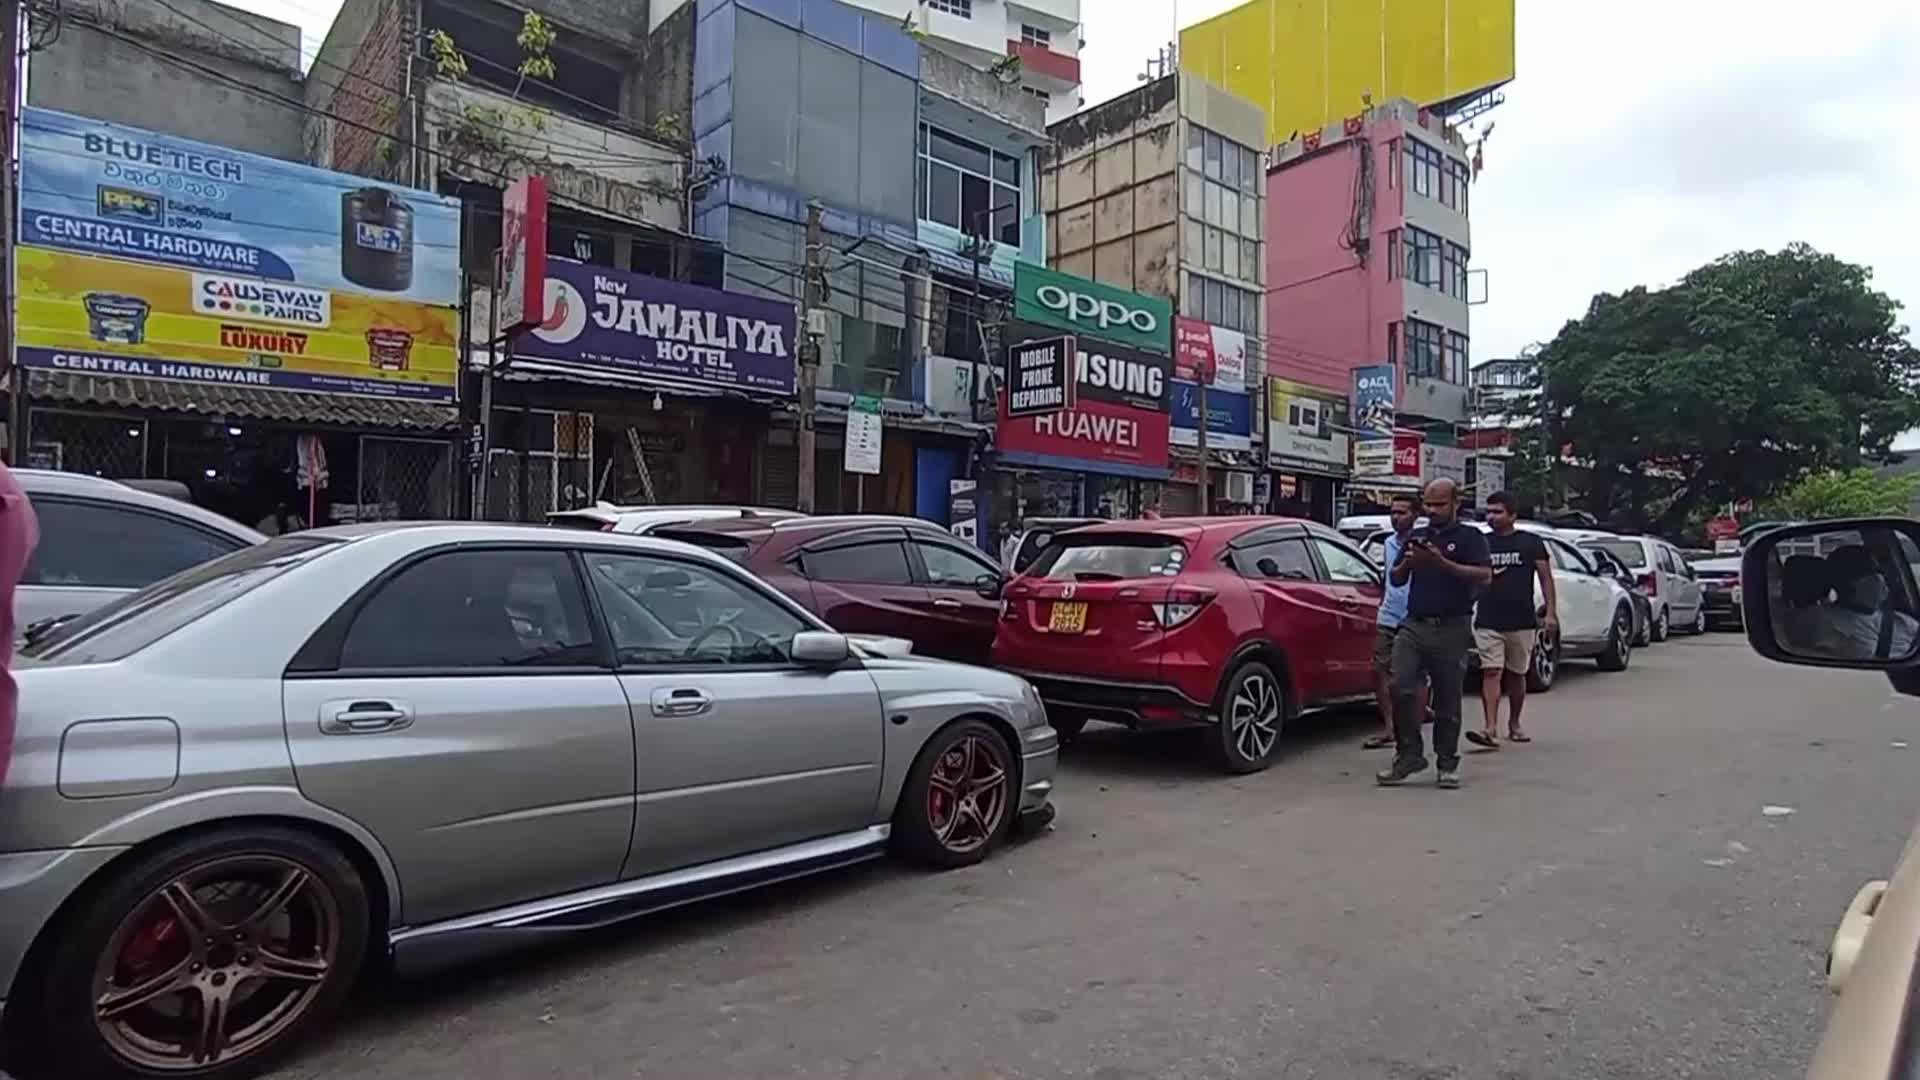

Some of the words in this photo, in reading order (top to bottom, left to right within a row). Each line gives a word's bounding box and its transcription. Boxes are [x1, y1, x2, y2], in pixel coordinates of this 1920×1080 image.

[35, 214, 141, 247] CENTRAL
[144, 233, 260, 265] HARDWARE
[203, 279, 323, 309] CAUSEWAY
[593, 275, 628, 295] New
[591, 292, 788, 357] JAMALIYA
[221, 331, 308, 355] LUXURY
[656, 340, 734, 369] HOTEL
[1020, 346, 1056, 369] MOBILE
[52, 353, 155, 375] CENTRAL
[160, 361, 271, 385] HARDWARE
[1022, 367, 1054, 388] PHONE
[1012, 386, 1063, 409] REPAIRING
[1034, 411, 1138, 448] HUAWEI
